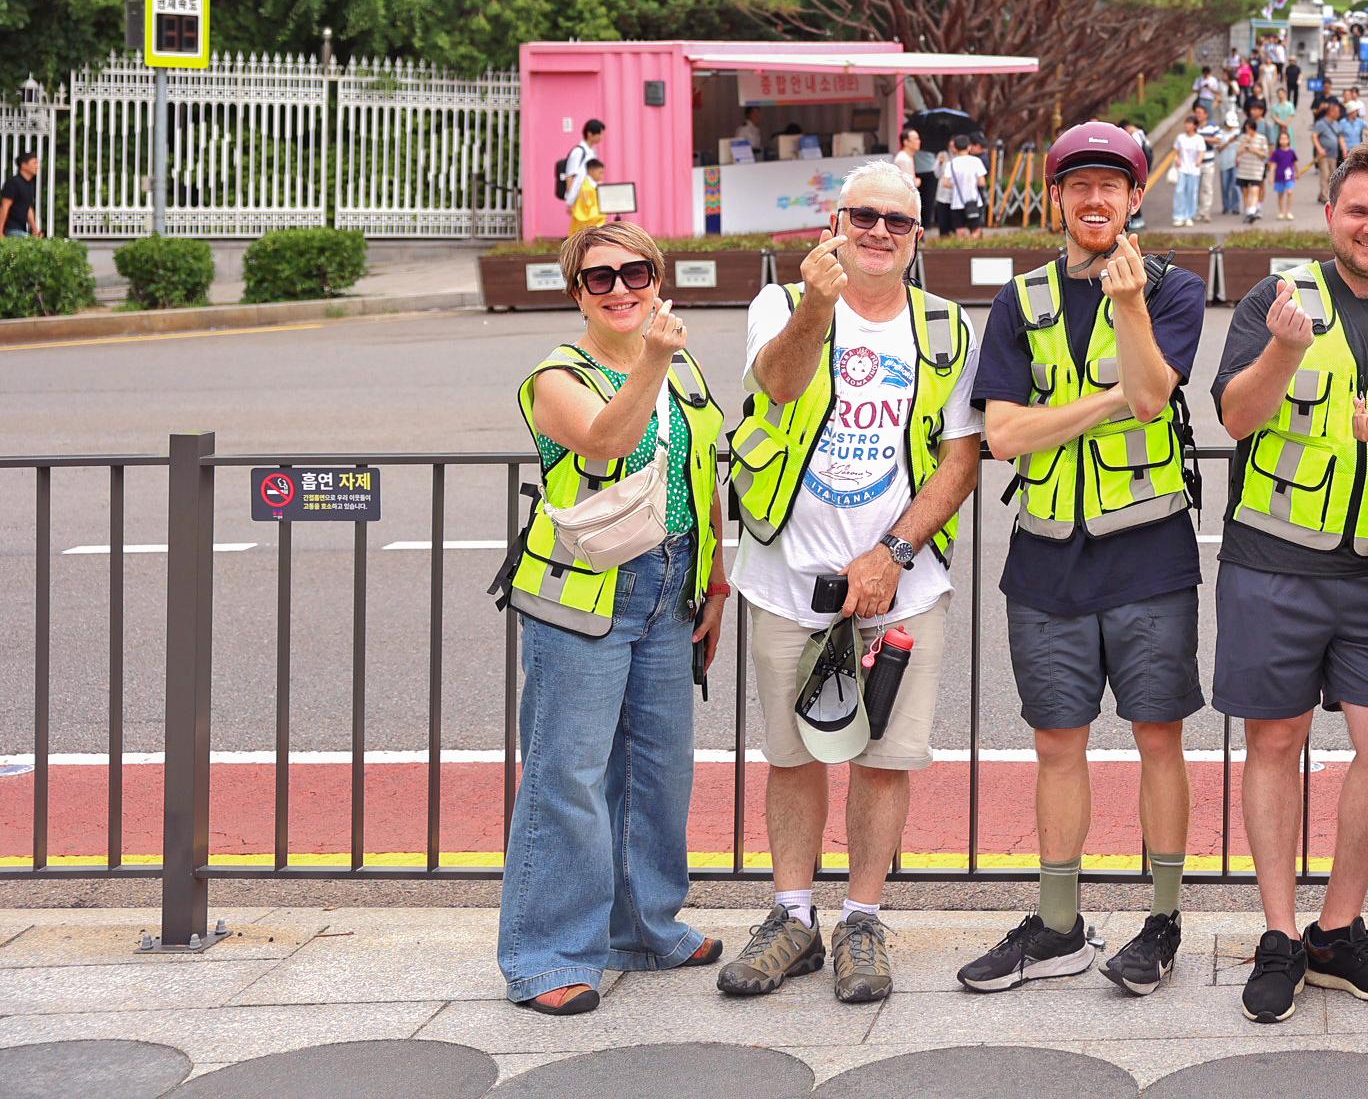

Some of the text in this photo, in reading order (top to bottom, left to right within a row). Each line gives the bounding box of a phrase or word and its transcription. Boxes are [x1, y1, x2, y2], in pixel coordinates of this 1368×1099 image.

[845, 377, 868, 386] ROMA
[829, 397, 912, 430] RONI
[301, 472, 371, 490] 흡연 자제
